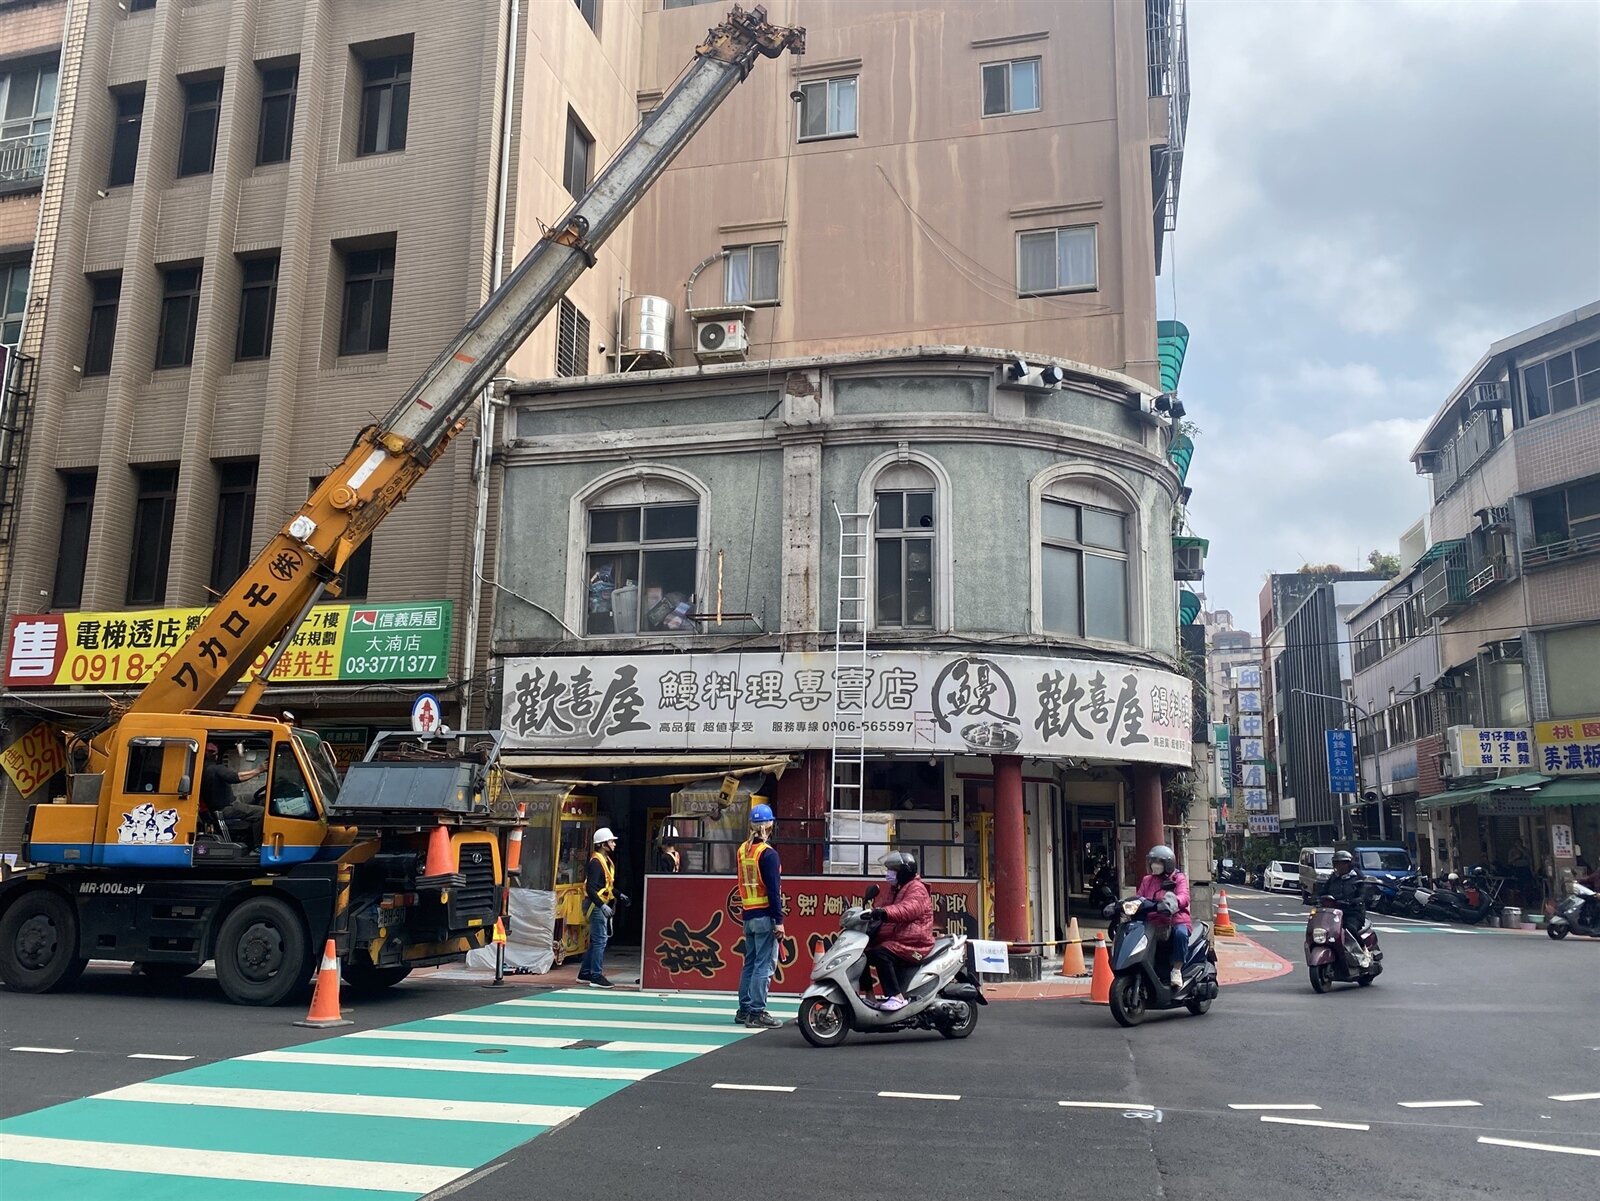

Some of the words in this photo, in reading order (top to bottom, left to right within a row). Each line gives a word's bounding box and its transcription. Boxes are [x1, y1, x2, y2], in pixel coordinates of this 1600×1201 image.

[379, 611, 438, 628] 信義房屋
[76, 618, 181, 650] 電梯透店
[365, 634, 422, 652] 大湳店
[9, 621, 59, 678] 售
[346, 655, 437, 673] 03-3771377
[511, 663, 652, 738] 歡喜屋
[658, 666, 919, 711] 鰻料理專賣店
[1035, 669, 1151, 747] 歡喜屋
[659, 721, 696, 733] 高品質
[702, 721, 754, 733] 超值享受
[772, 721, 819, 733] 服務專線
[822, 721, 914, 733] 0906-565597
[1480, 742, 1529, 753] 切仔麵
[1481, 754, 1530, 765] 甜不辣
